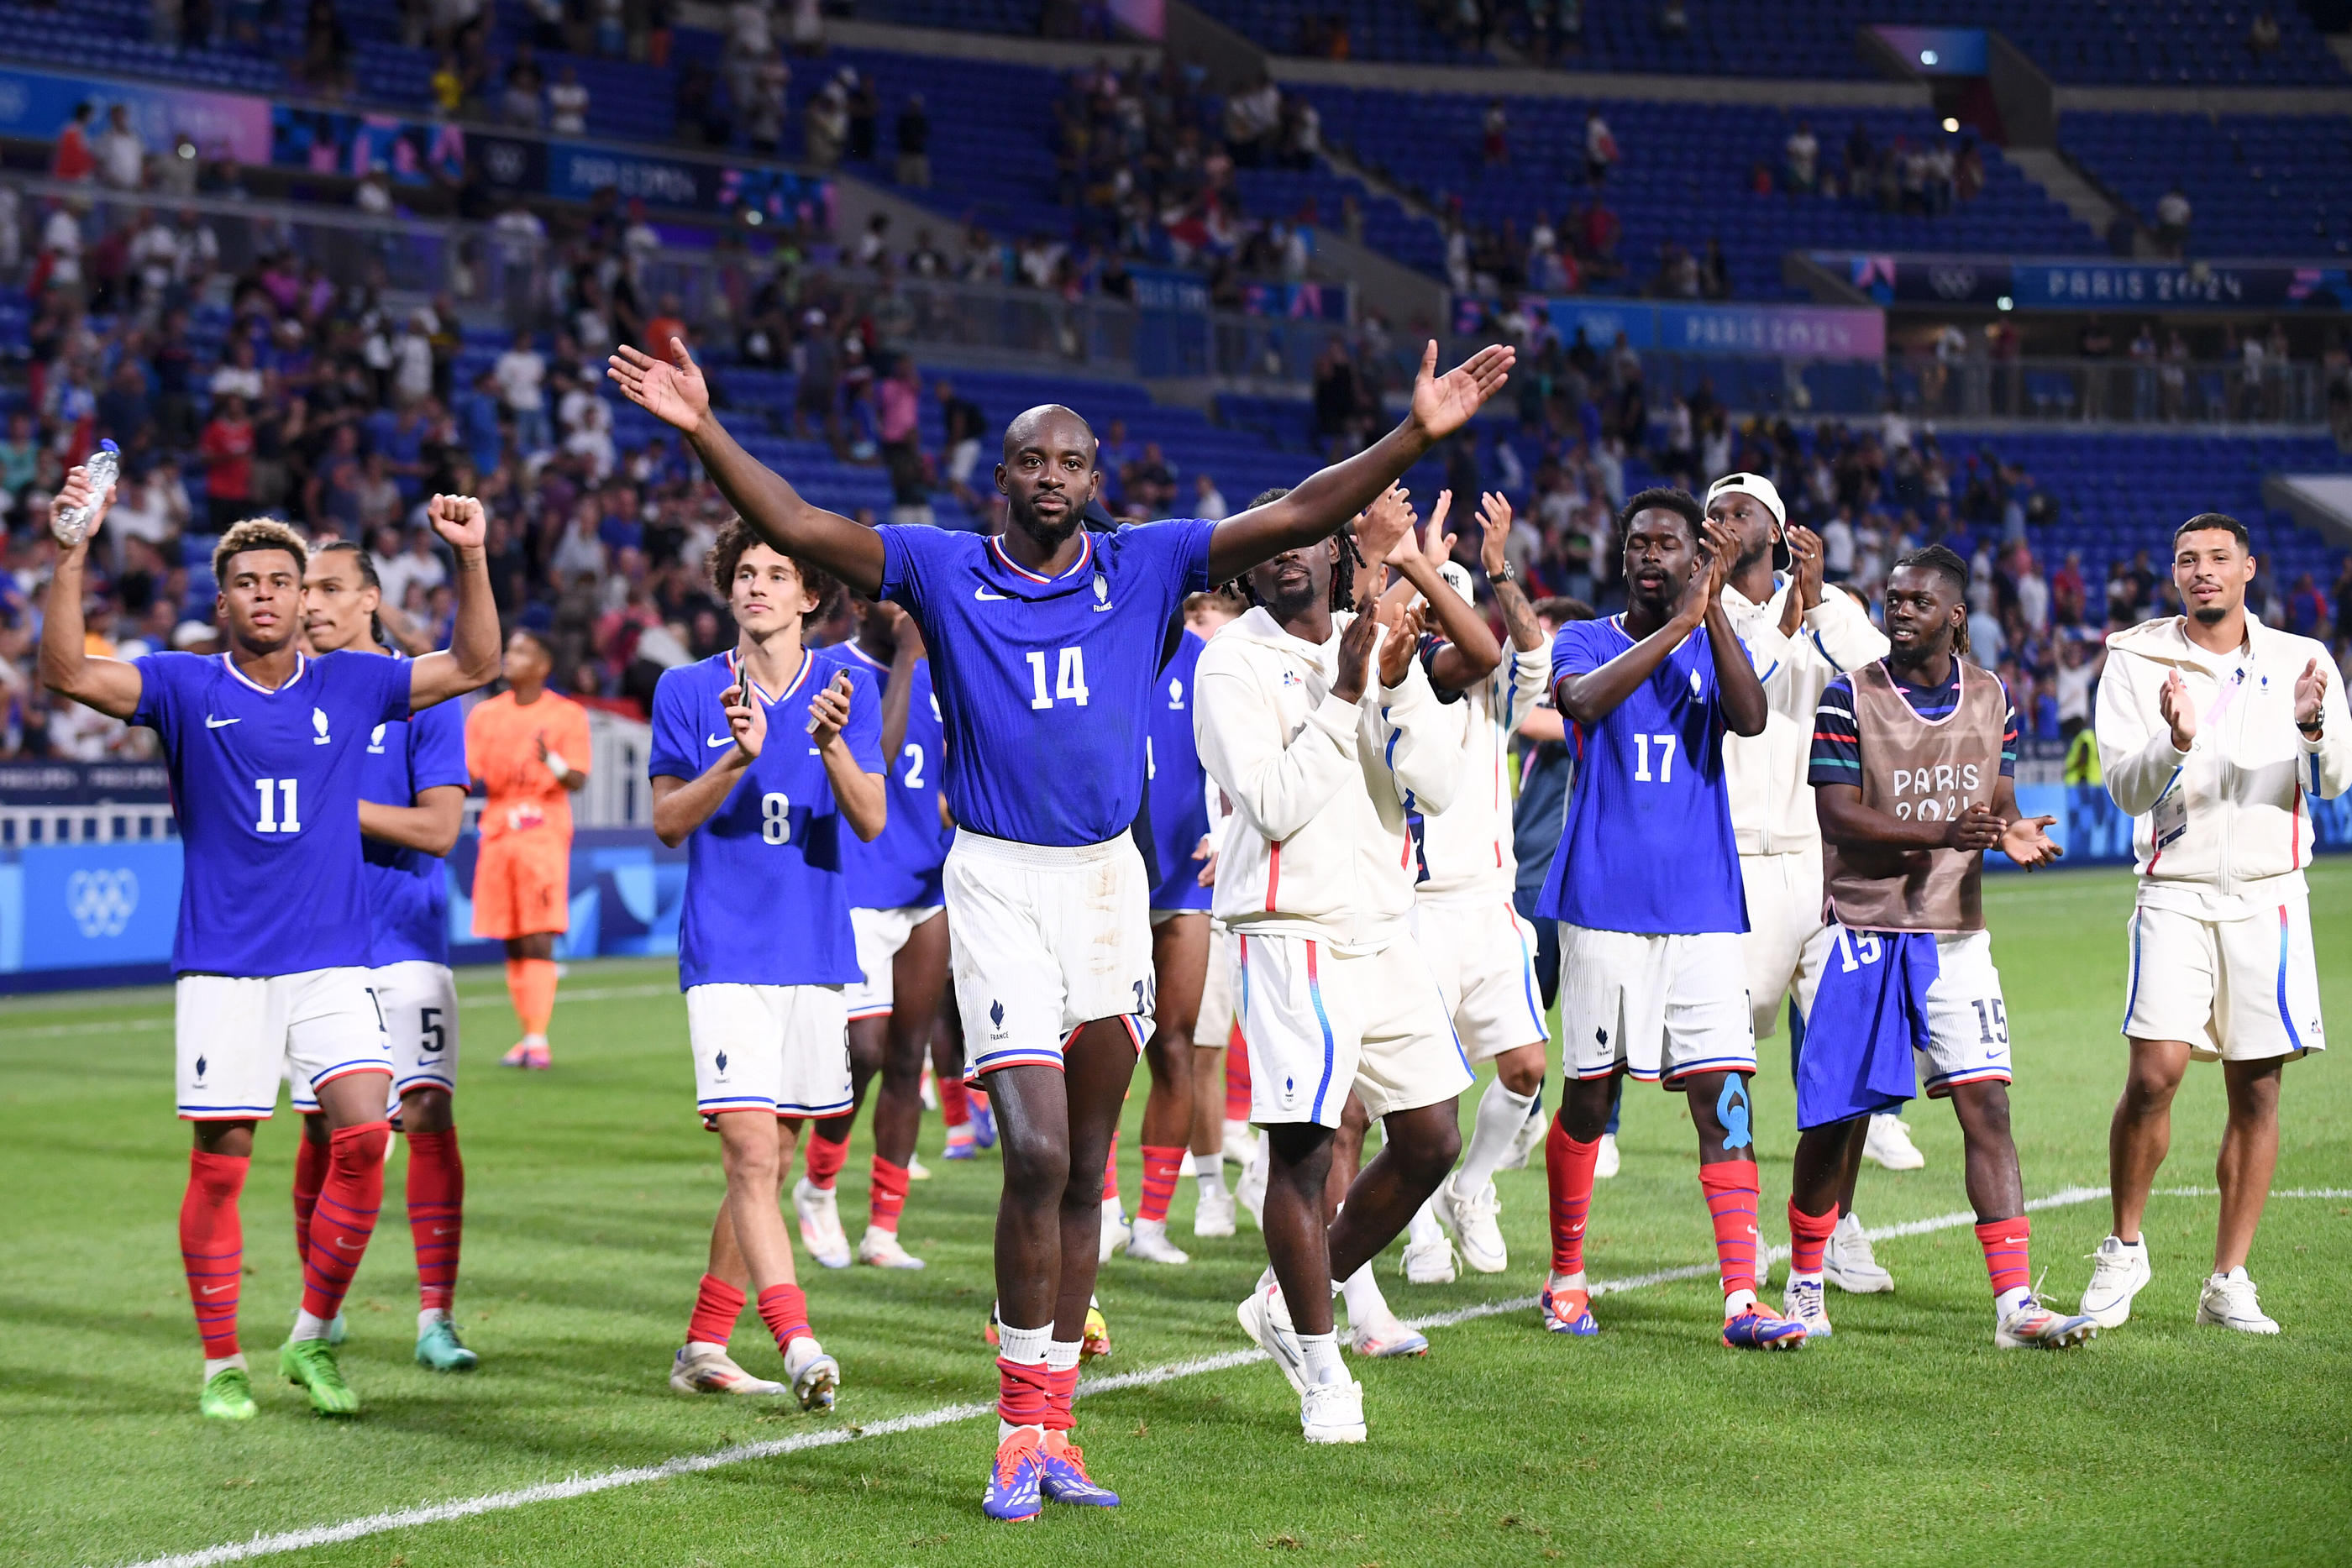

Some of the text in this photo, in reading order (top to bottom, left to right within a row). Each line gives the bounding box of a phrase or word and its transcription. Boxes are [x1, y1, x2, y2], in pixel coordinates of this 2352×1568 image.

[1443, 573, 1459, 588] NCE
[1026, 646, 1089, 710] 14
[904, 743, 924, 789] 2
[1633, 733, 1676, 783] 17
[255, 778, 301, 832] 11
[761, 792, 791, 846] 8
[1836, 926, 1882, 973] 15
[421, 1007, 445, 1051] 5
[990, 1030, 1009, 1042] FRANCE
[1971, 998, 2008, 1044] 15
